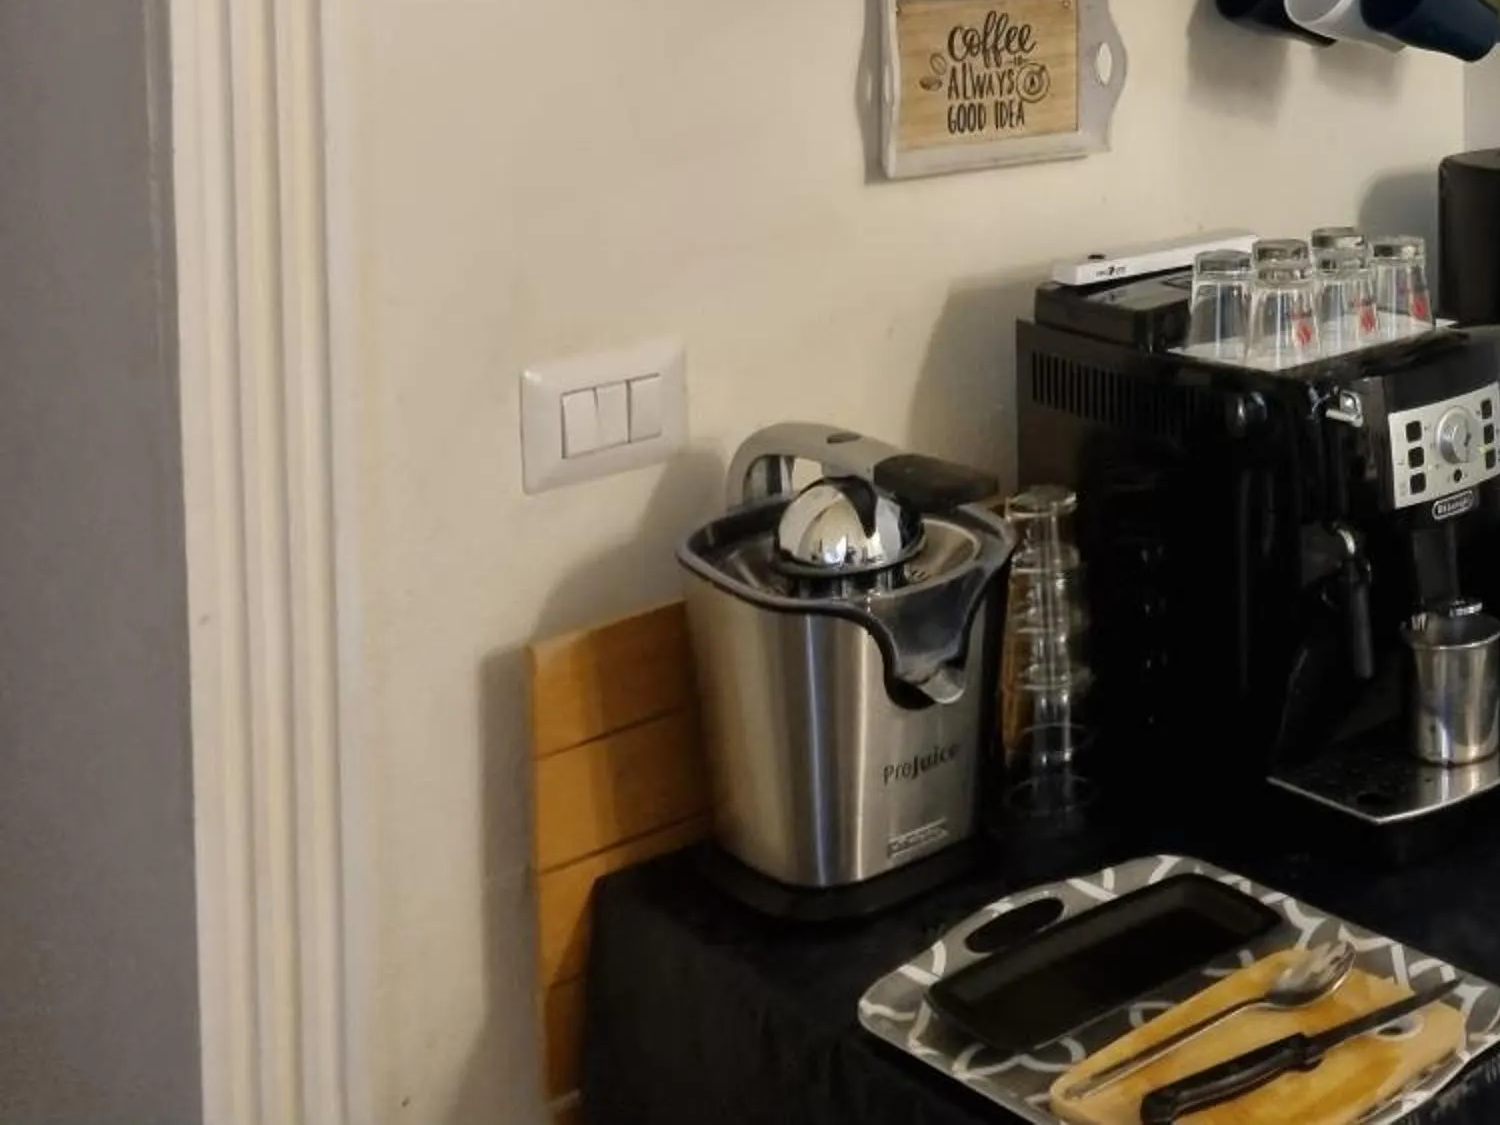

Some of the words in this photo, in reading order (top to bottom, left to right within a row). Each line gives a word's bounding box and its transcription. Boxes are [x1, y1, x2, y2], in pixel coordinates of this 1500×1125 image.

[947, 10, 1037, 69] Coffee
[947, 62, 1015, 100] ALWAYS
[947, 102, 987, 134] GOOD
[994, 99, 1025, 130] IDEA
